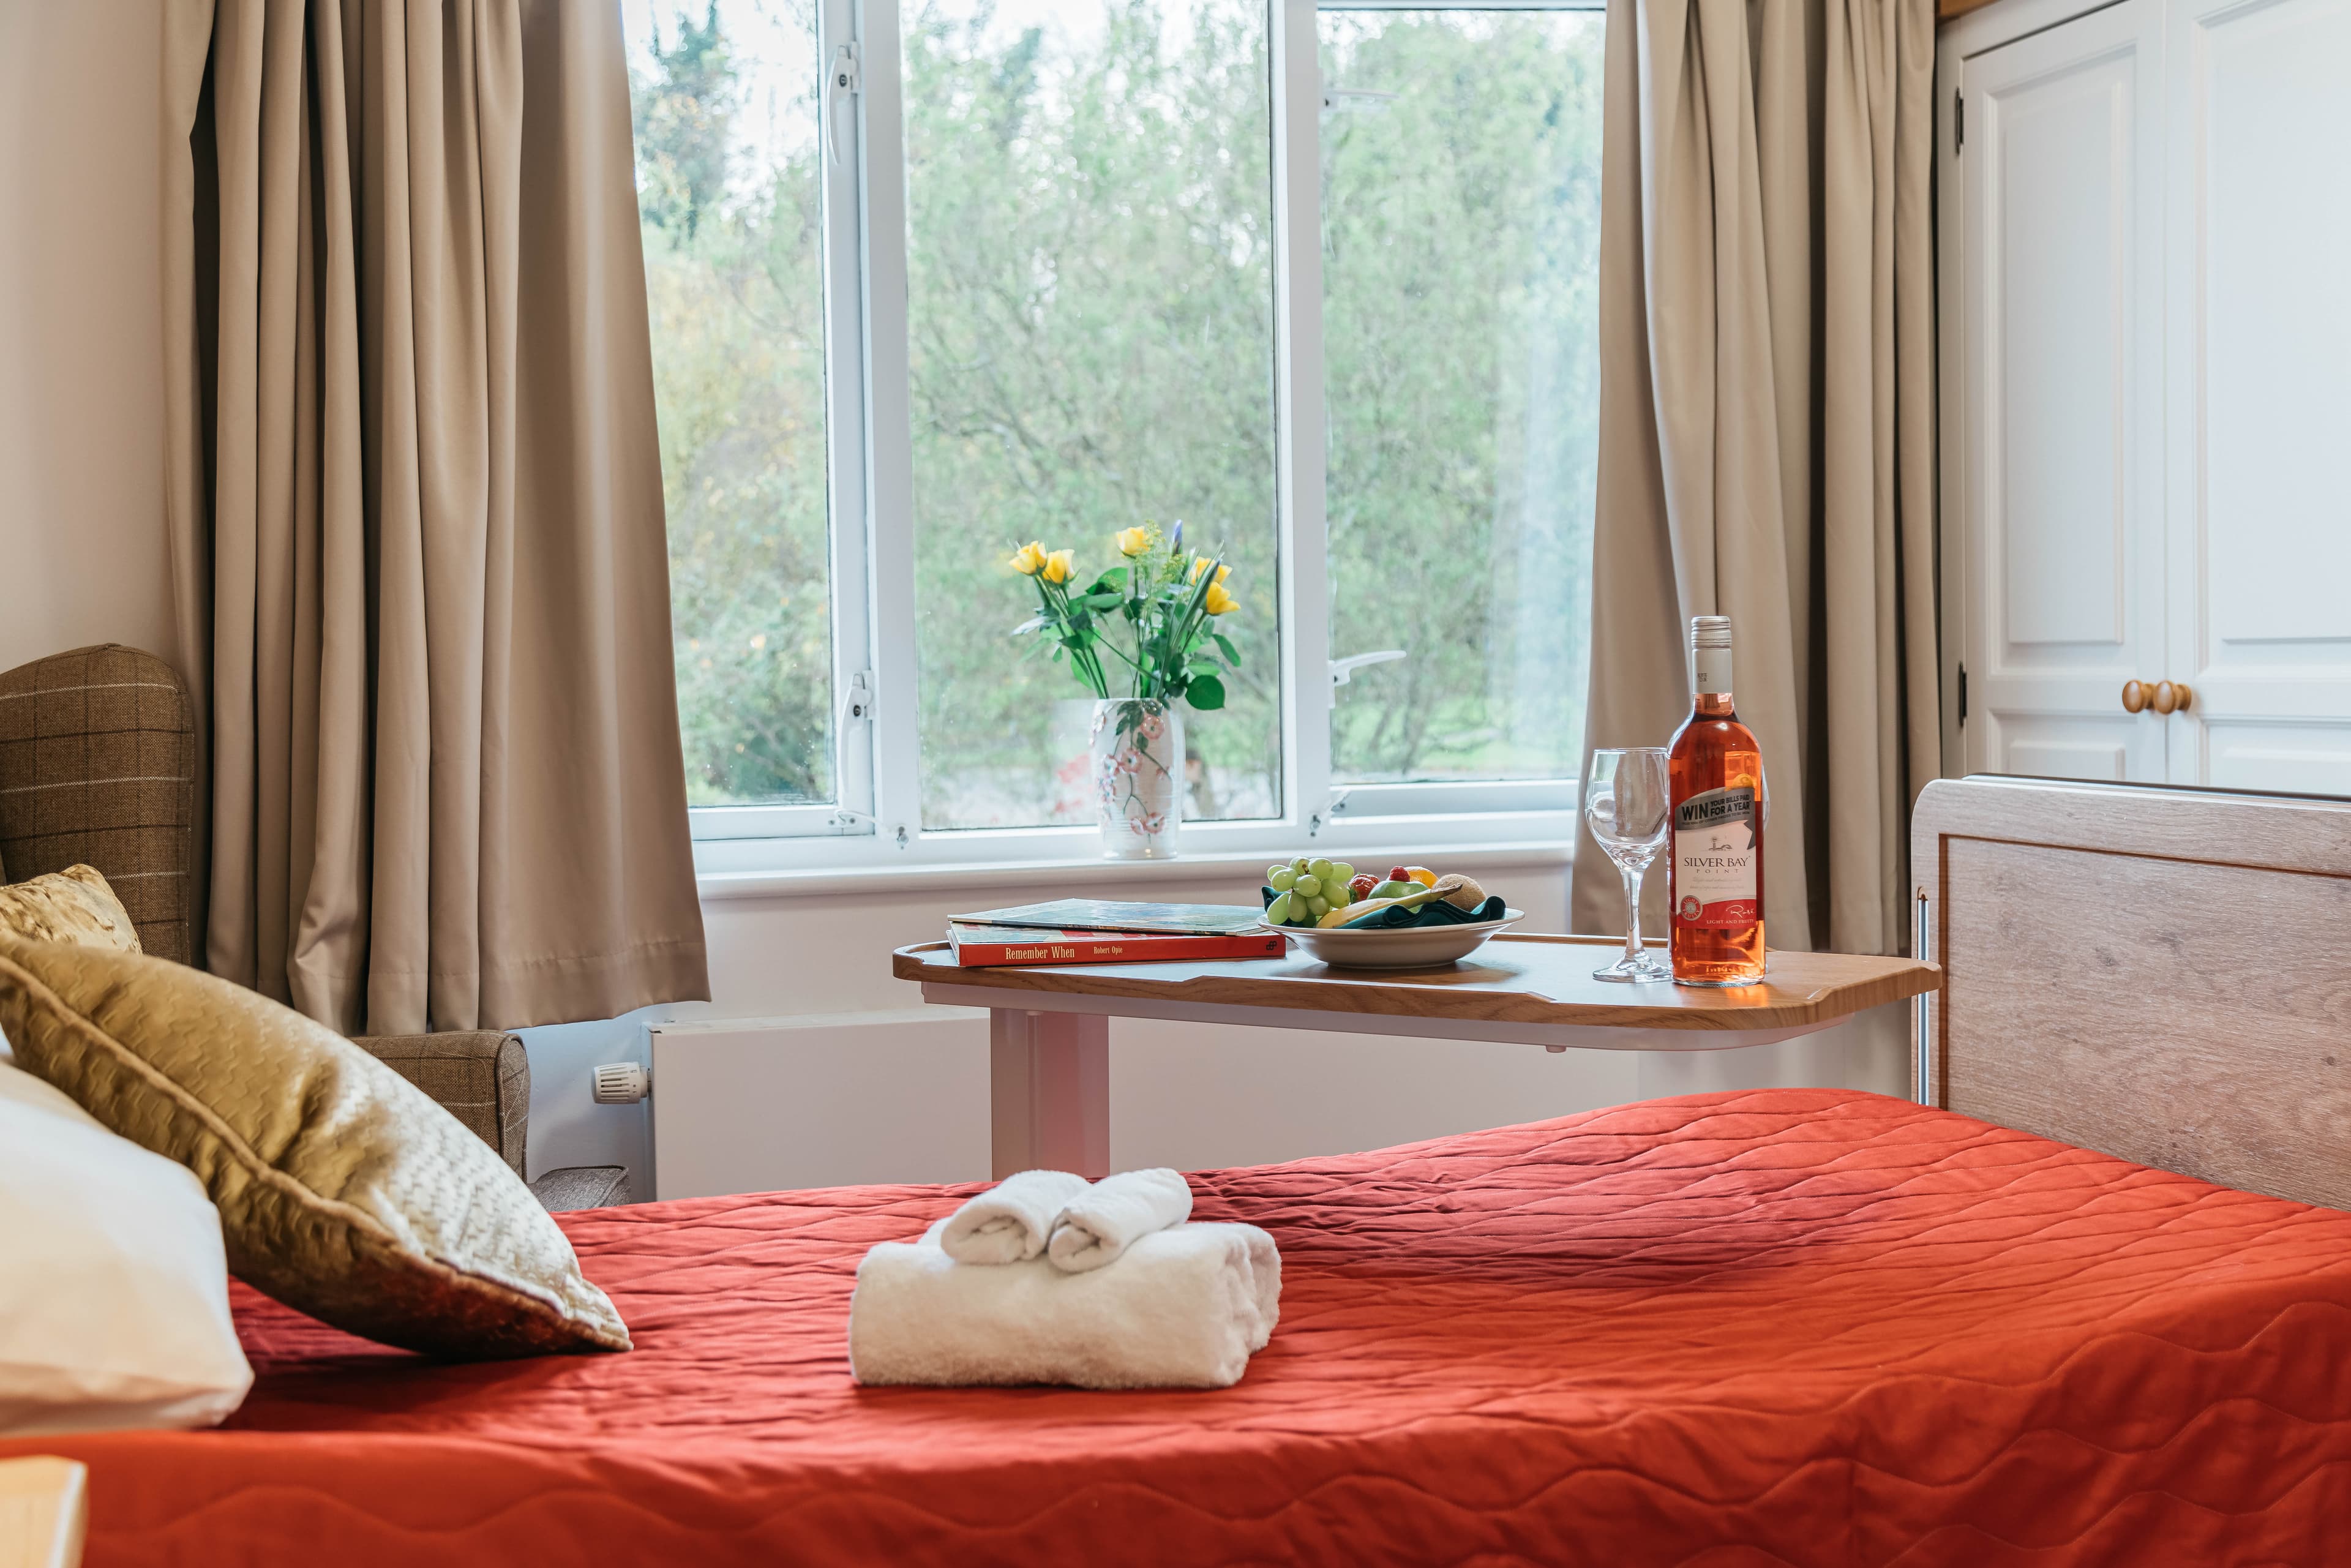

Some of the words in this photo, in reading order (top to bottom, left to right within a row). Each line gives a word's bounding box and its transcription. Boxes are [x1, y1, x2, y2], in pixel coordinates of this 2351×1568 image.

[1682, 803, 1708, 820] WIN
[1711, 798, 1725, 808] YOUR
[1711, 805, 1725, 816] FOR
[1727, 804, 1732, 812] A
[1734, 801, 1750, 811] YEAR
[1684, 857, 1725, 867] SILVER
[1727, 857, 1749, 867] BAY
[1726, 905, 1756, 918] Rosé
[1005, 947, 1048, 960] Remember
[1051, 946, 1075, 958] When
[1111, 946, 1123, 955] Opie
